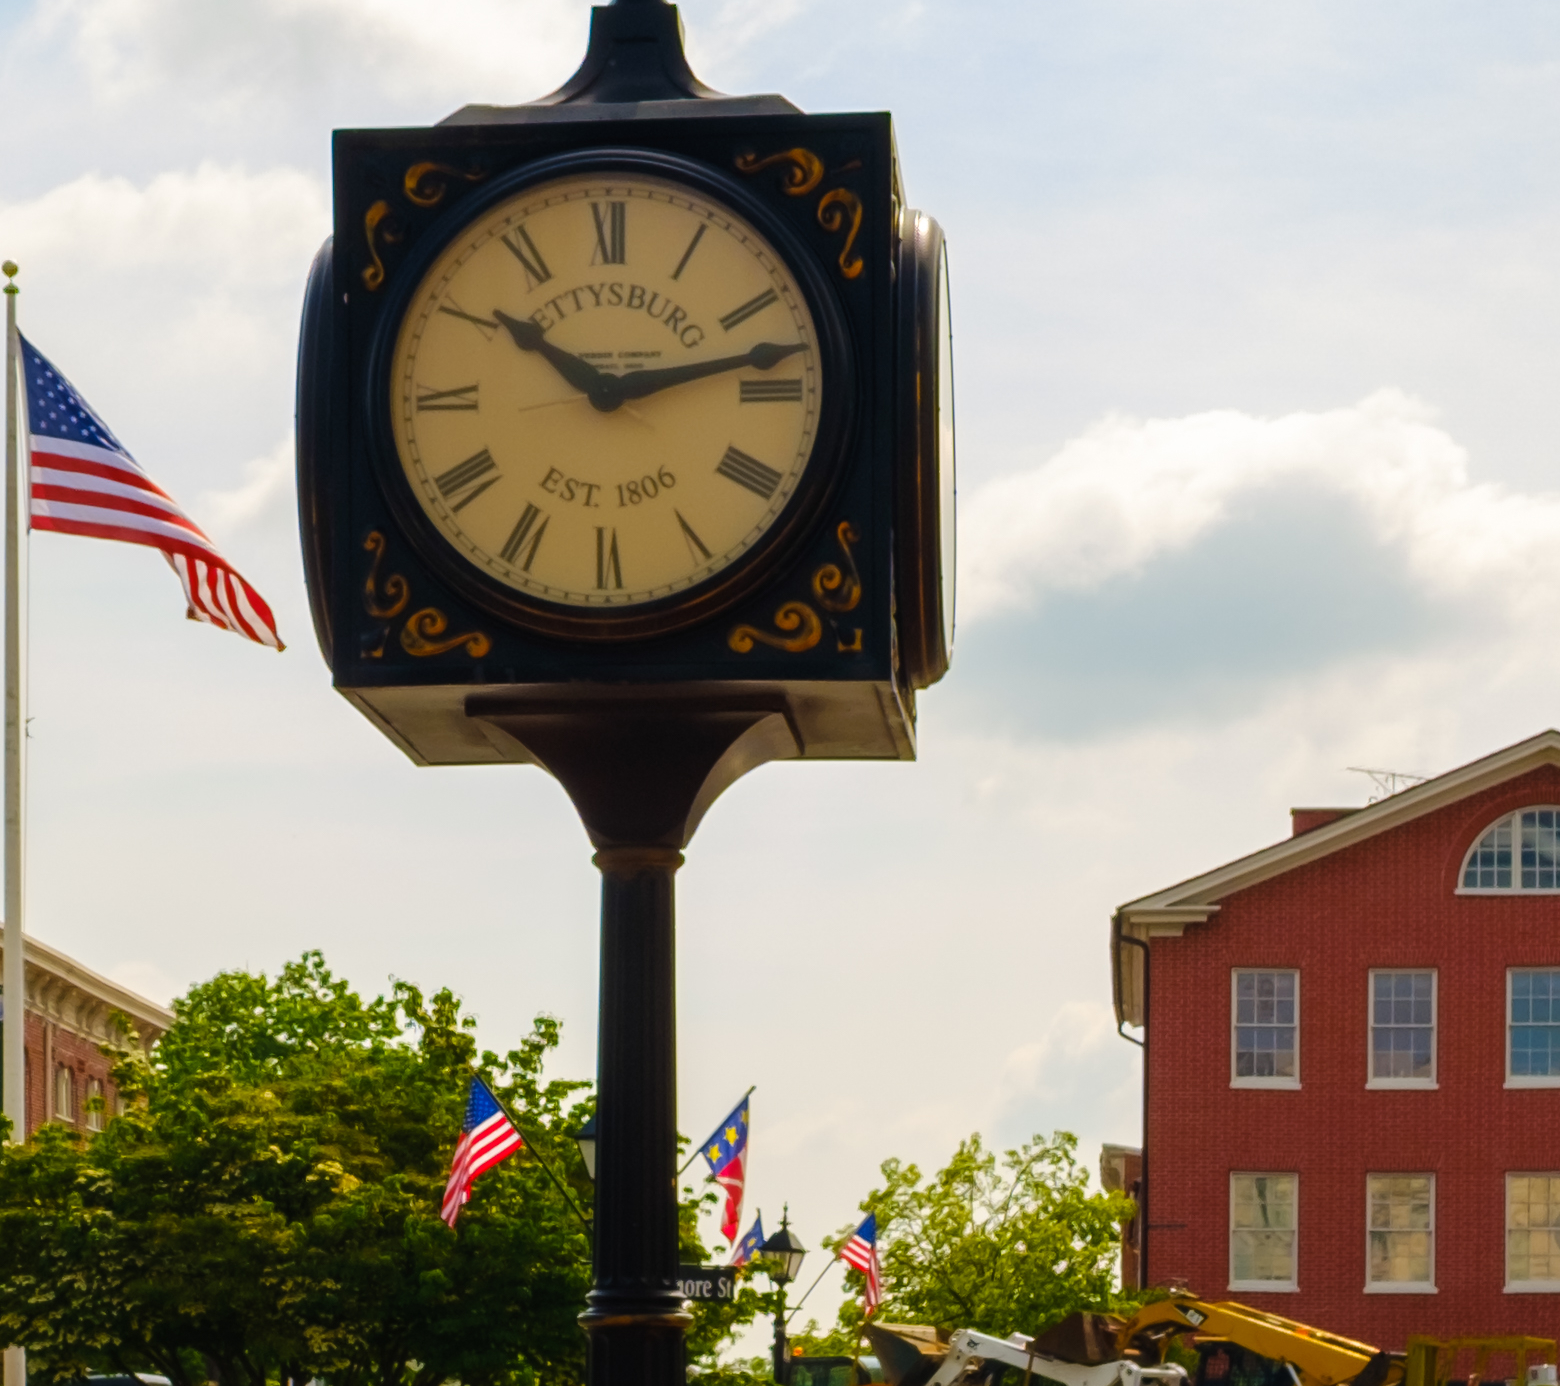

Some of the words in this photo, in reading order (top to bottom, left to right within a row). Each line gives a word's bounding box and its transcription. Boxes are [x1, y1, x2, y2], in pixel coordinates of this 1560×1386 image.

[530, 282, 706, 349] ETTYSBURG
[538, 465, 601, 508] EST.
[616, 464, 676, 508] 1806
